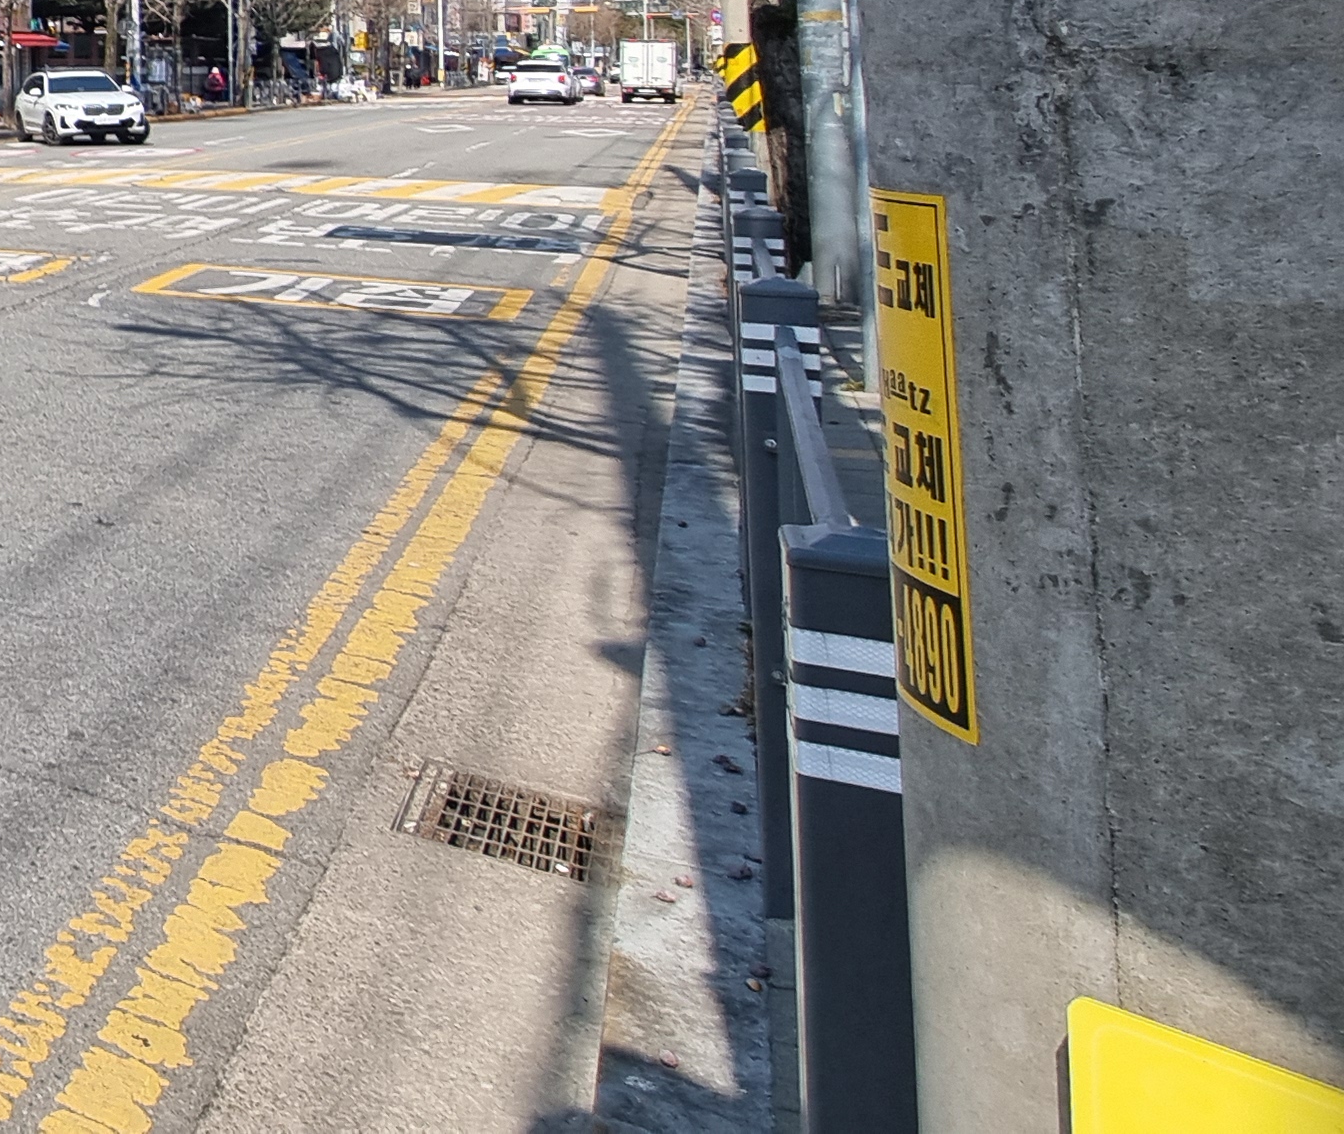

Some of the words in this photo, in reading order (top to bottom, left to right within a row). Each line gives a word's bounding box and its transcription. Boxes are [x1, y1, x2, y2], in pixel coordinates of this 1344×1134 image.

[196, 270, 475, 315] 기점
[895, 259, 936, 319] 교체
[891, 420, 946, 504] 교체
